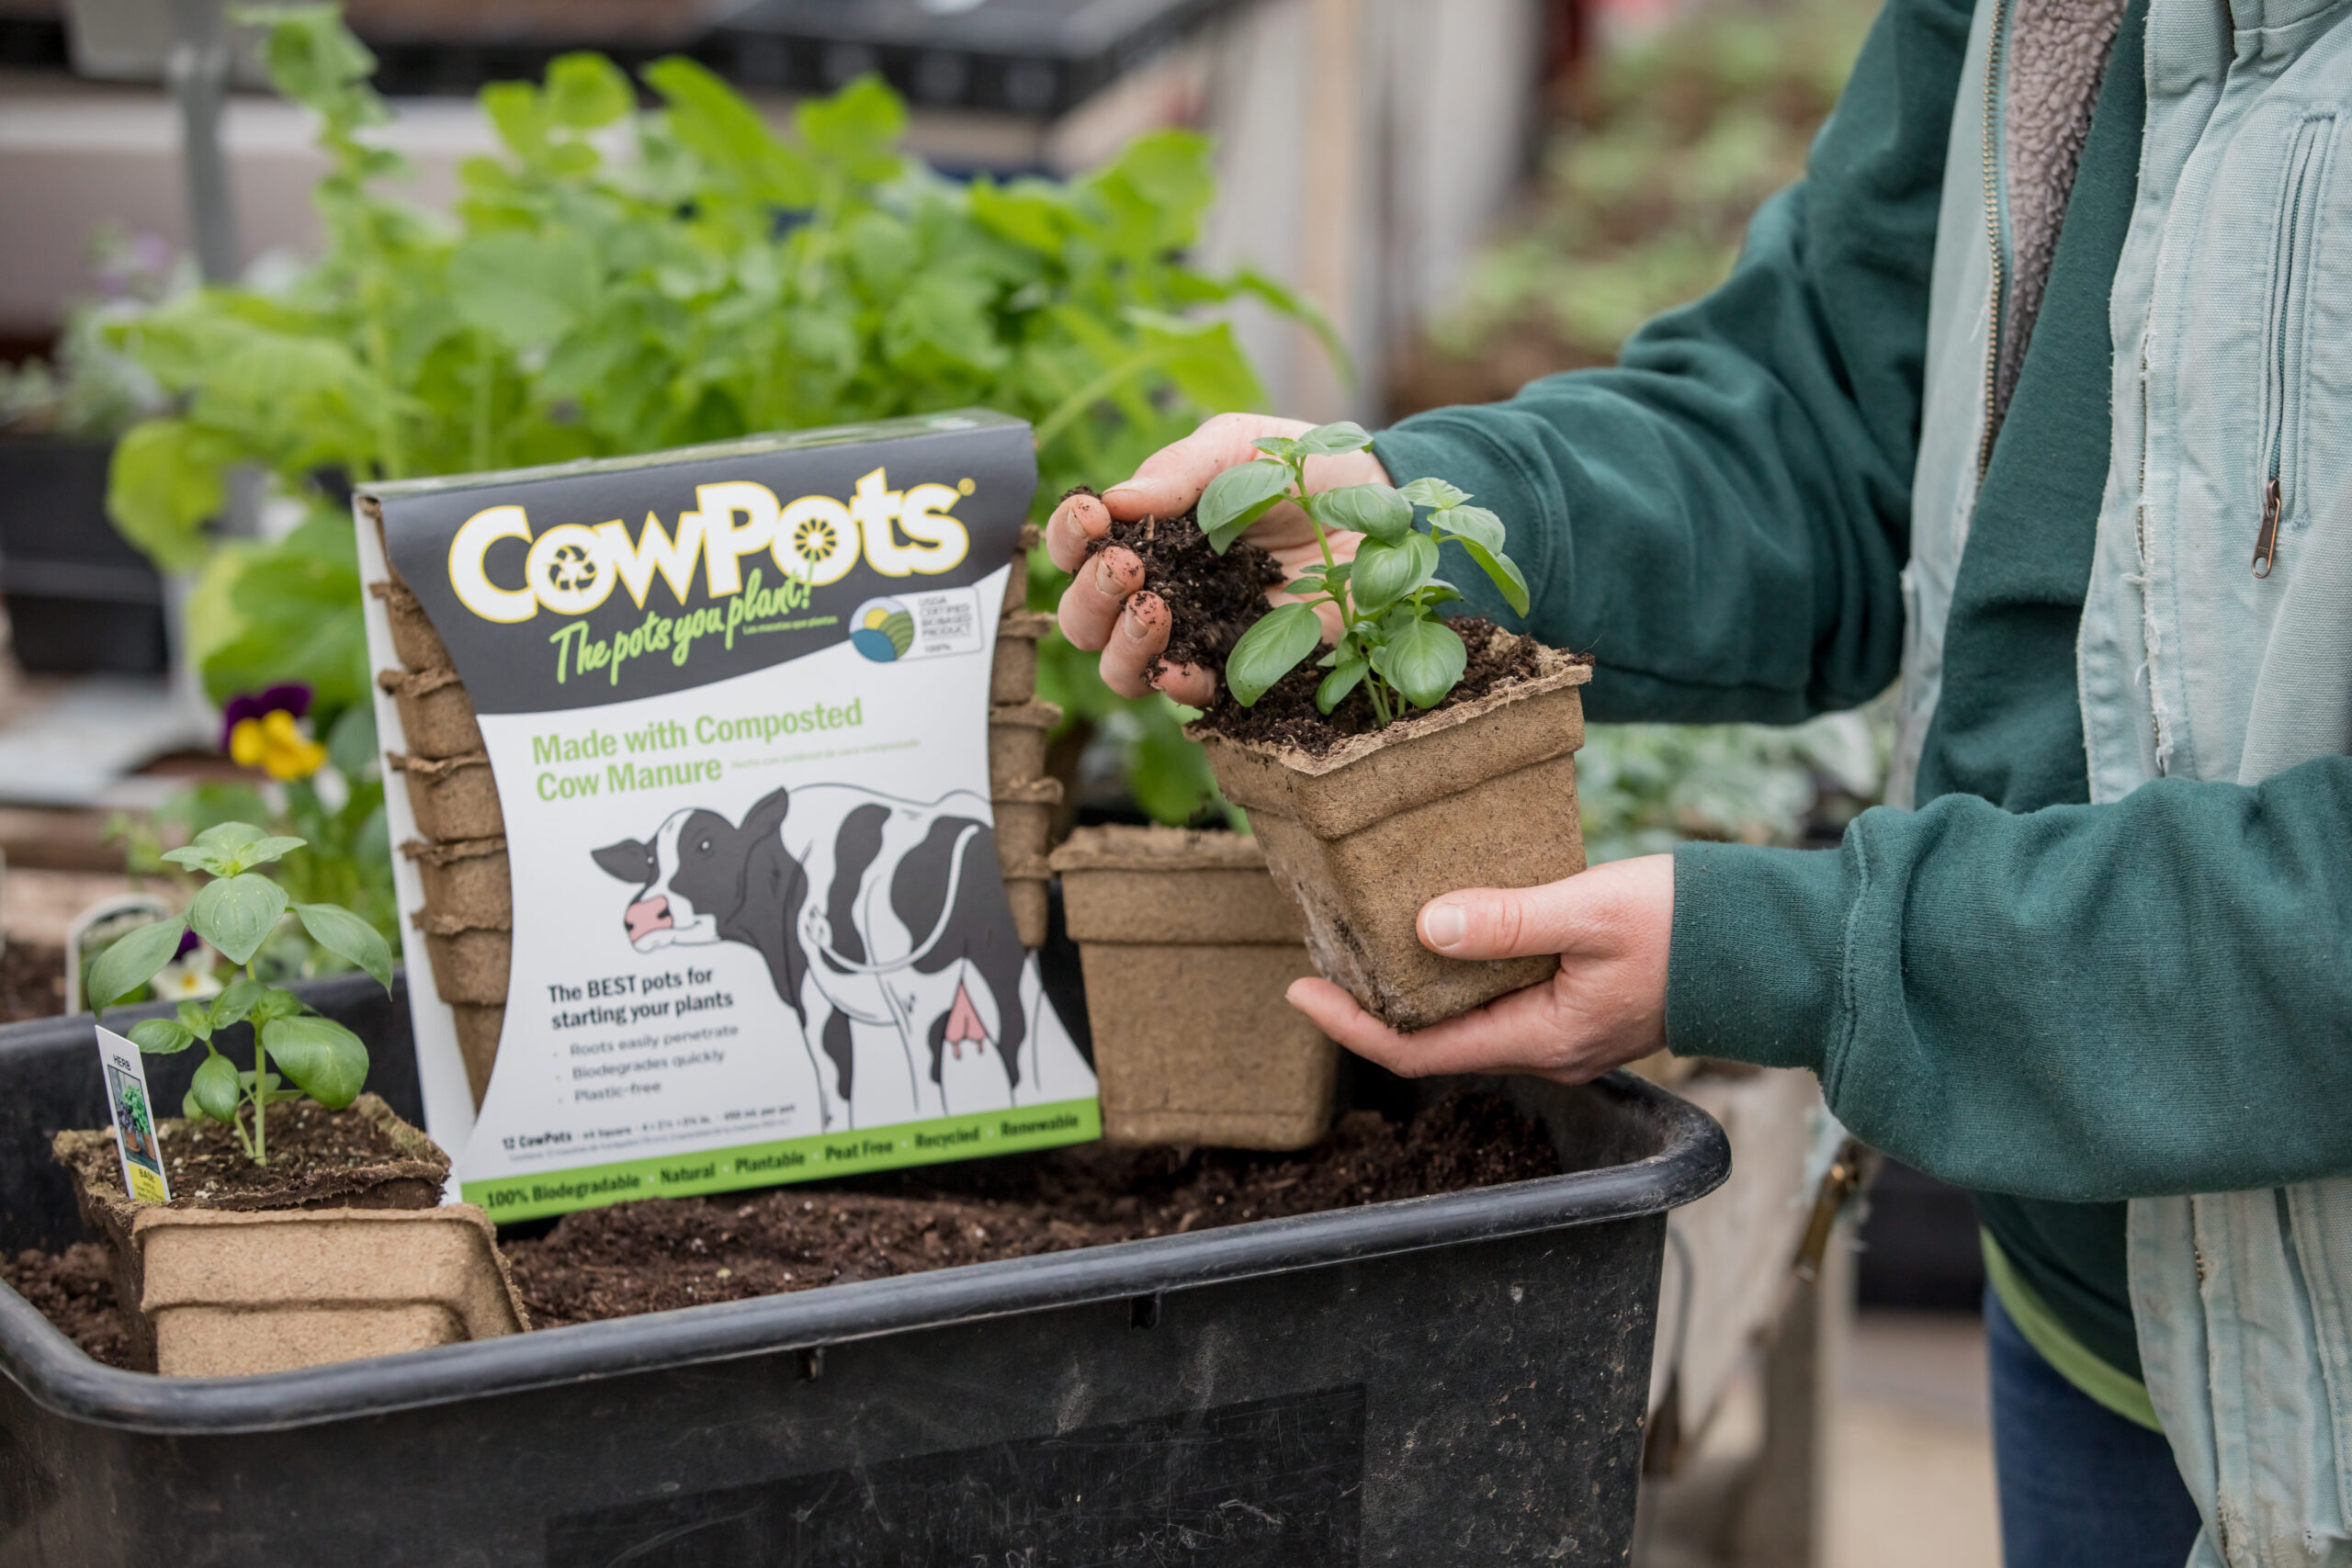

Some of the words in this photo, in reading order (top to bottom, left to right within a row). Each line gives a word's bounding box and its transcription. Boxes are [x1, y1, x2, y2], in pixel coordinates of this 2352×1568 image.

[549, 620, 612, 685] The
[610, 611, 673, 686] pots
[672, 606, 726, 667] you
[724, 550, 817, 650] plant!
[532, 728, 618, 765] Made
[623, 719, 686, 753] with
[695, 697, 863, 743] Composted
[536, 772, 600, 802] Cow
[607, 758, 723, 795] Manure
[548, 984, 582, 1003] The
[587, 975, 638, 999] BEST
[642, 972, 683, 996] pots
[687, 967, 714, 986] for
[551, 1005, 627, 1030] starting
[630, 1000, 671, 1024] your
[673, 990, 734, 1018] plants
[570, 1039, 614, 1056] Roots
[618, 1033, 660, 1050] easily
[662, 1025, 740, 1046] penetrate
[113, 1053, 131, 1072] HERB
[571, 1055, 668, 1079] Biodegrades
[672, 1049, 726, 1069] quickly
[574, 1080, 662, 1102] Plastic-free
[487, 1190, 529, 1209] 100%
[533, 1172, 640, 1203] Biodegradable
[660, 1162, 716, 1185] Natural
[735, 1151, 806, 1176] Plantable
[825, 1143, 859, 1161] Peat
[862, 1139, 894, 1156] Free
[915, 1127, 980, 1150] Recycled
[1001, 1113, 1080, 1137] Renewable
